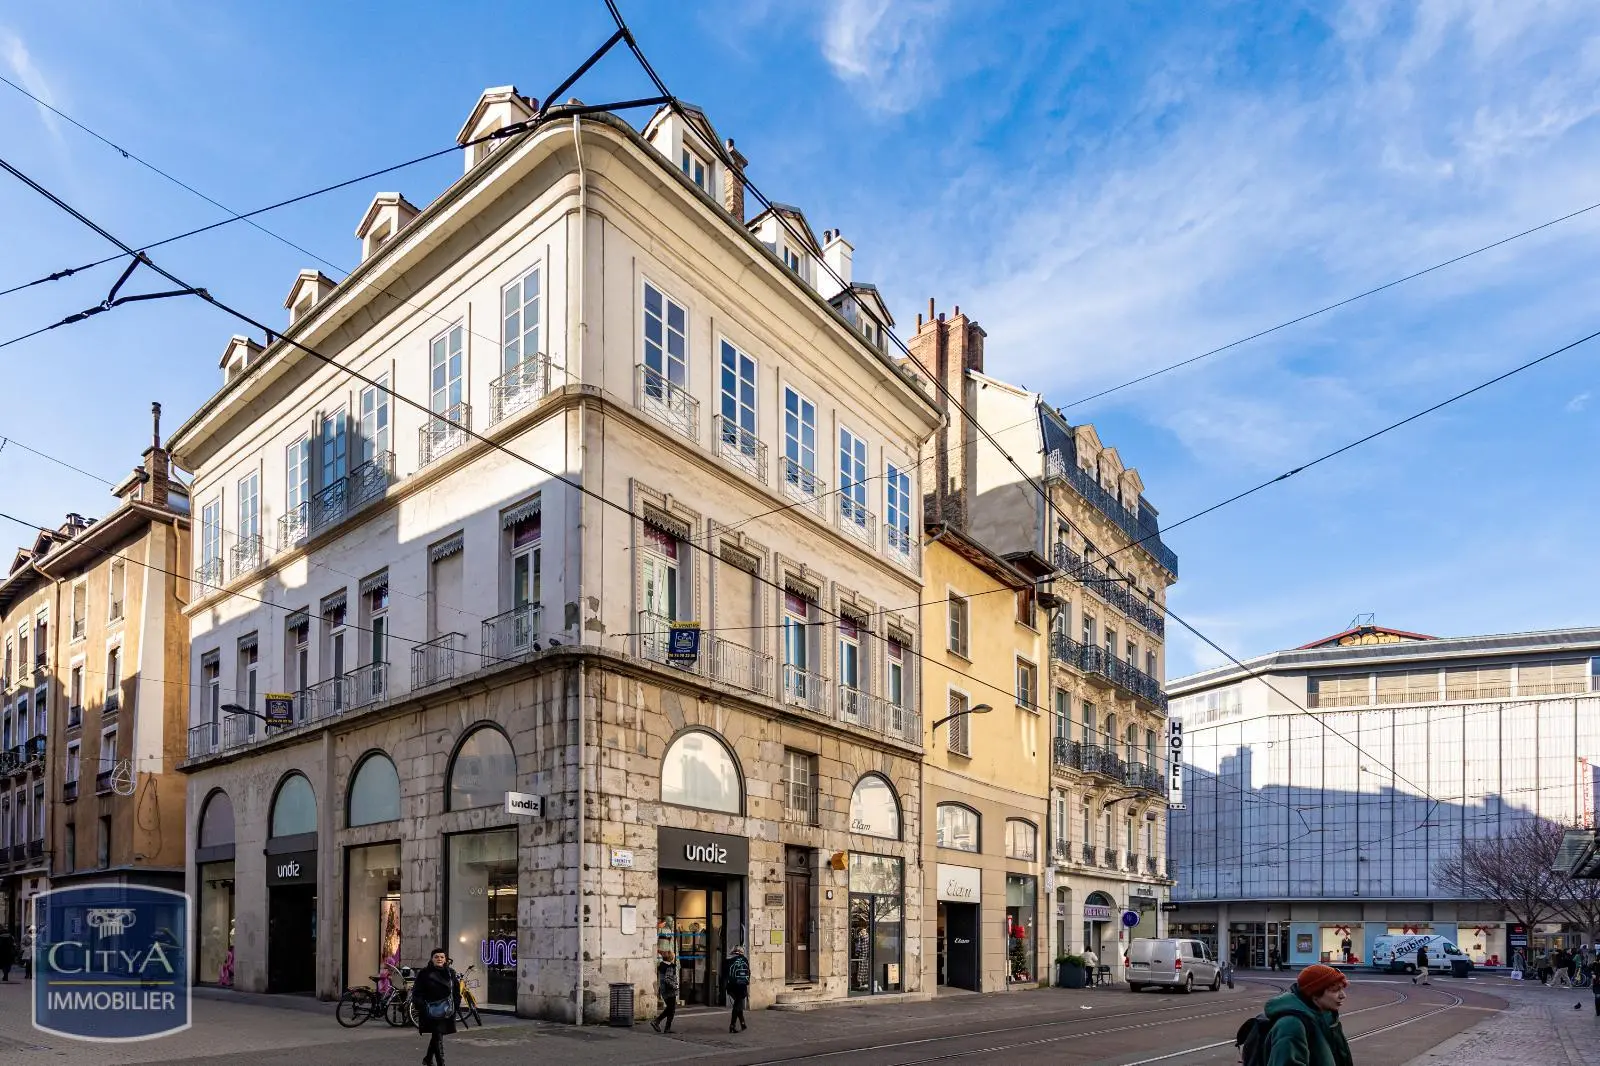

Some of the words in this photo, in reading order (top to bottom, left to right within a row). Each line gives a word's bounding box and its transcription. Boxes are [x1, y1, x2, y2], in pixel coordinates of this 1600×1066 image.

[1171, 722, 1182, 790] HOTEL
[511, 800, 539, 810] undiz
[851, 818, 871, 830] Etam
[686, 843, 727, 864] undiz
[277, 860, 300, 878] undiz
[946, 879, 972, 898] Etam
[1396, 935, 1431, 956] Rubino
